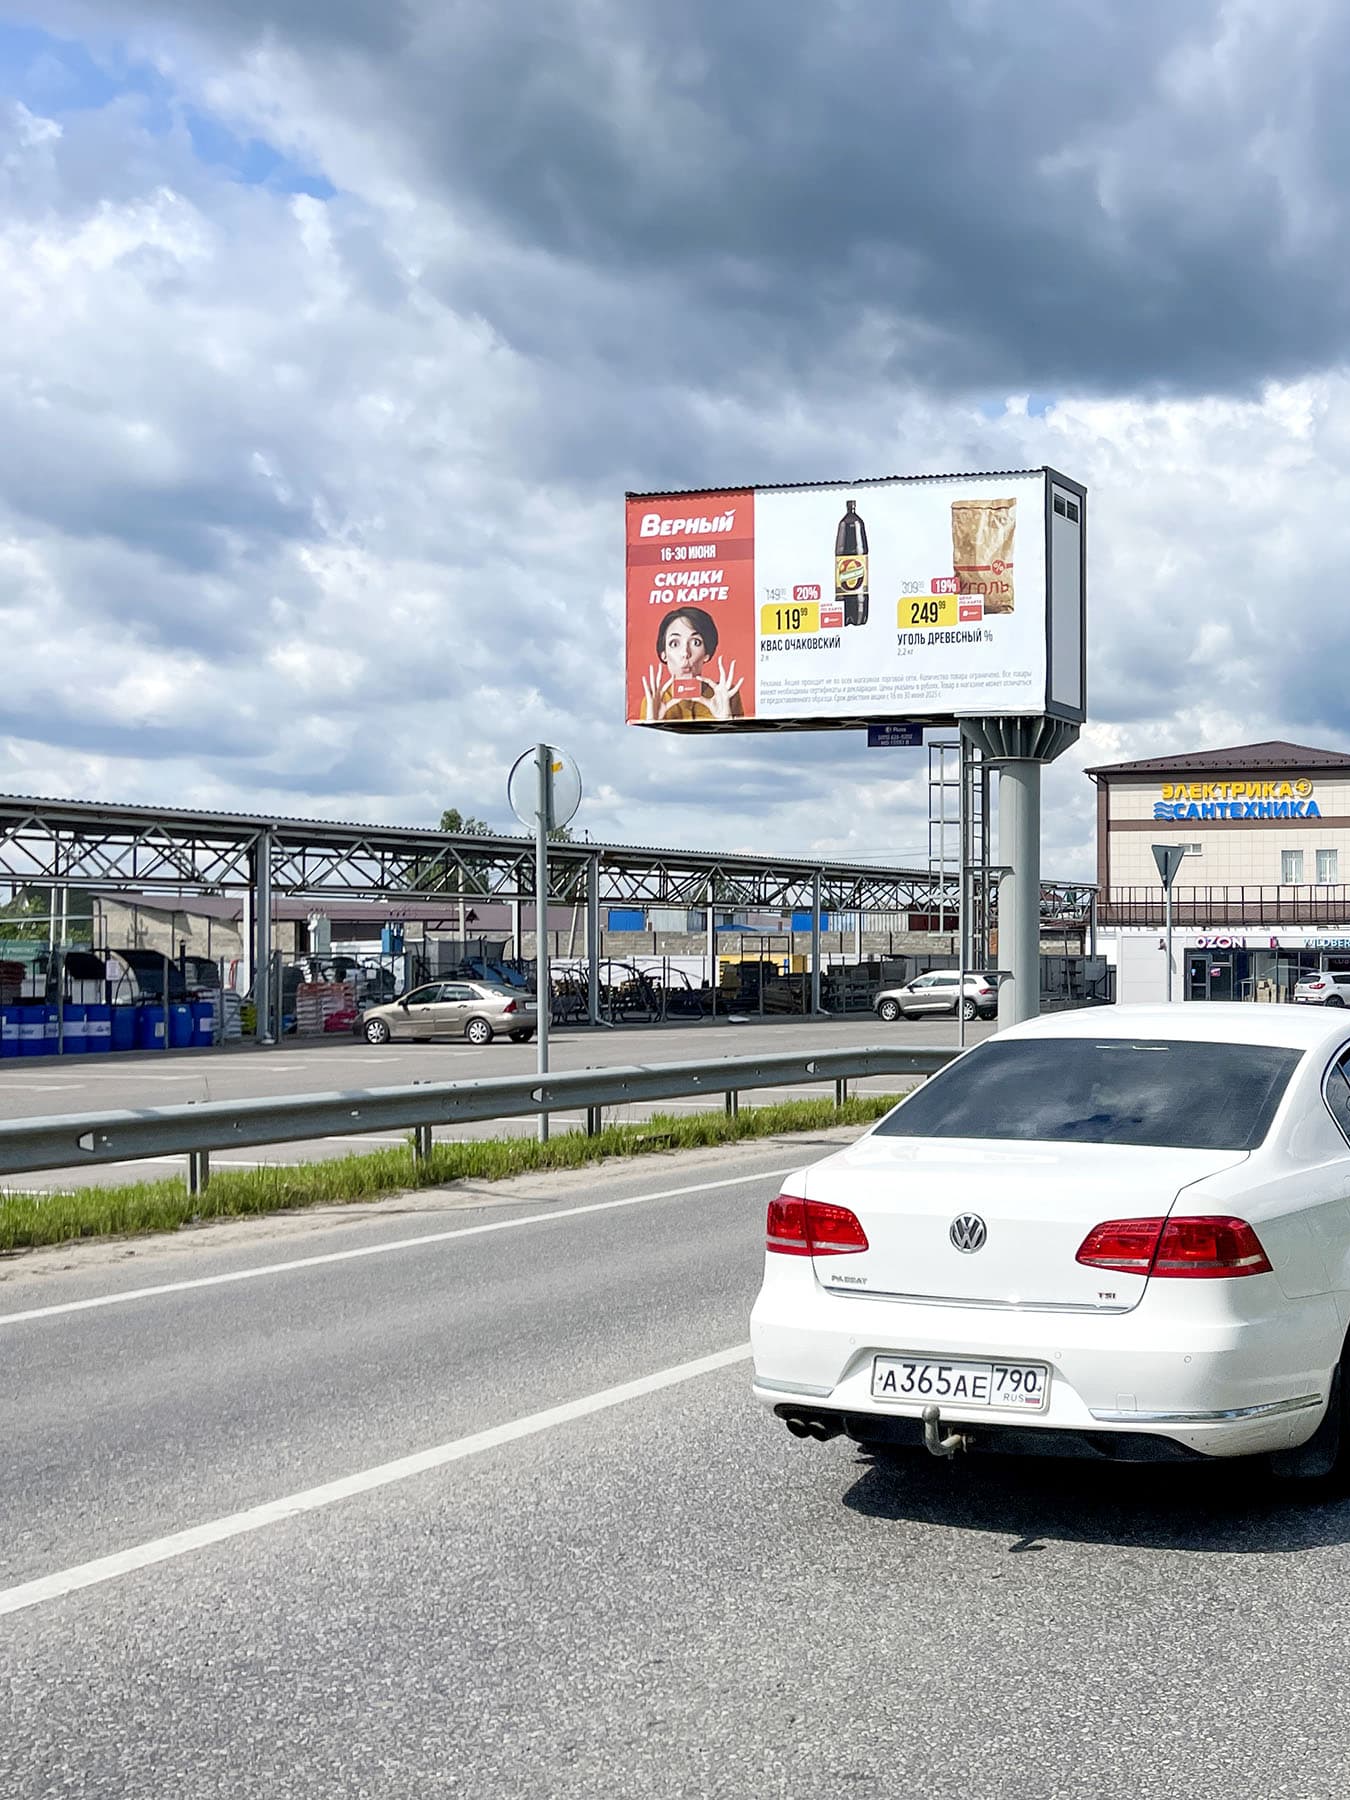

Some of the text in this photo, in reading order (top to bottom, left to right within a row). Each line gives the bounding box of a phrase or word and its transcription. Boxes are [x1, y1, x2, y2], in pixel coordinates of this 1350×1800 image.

[661, 544, 716, 561] 16-30 ИЮНЯ
[654, 570, 723, 587] СКИДКИ
[935, 579, 957, 593] 19%
[649, 586, 729, 604] ПО КАРТЕ
[796, 586, 818, 600] 20%
[760, 635, 841, 652] КВАС ОЧАКОВСКИЙ
[897, 633, 926, 646] УГОЛЬ
[927, 628, 982, 645] ДРЕВЕСНЫЙ
[1161, 781, 1294, 800] ЭЛЕКТРИКА
[1173, 801, 1322, 820] САНТЕХНИКА
[1196, 936, 1245, 948] OZON
[995, 1368, 1037, 1393] 790
[1003, 1393, 1024, 1402] RUS
